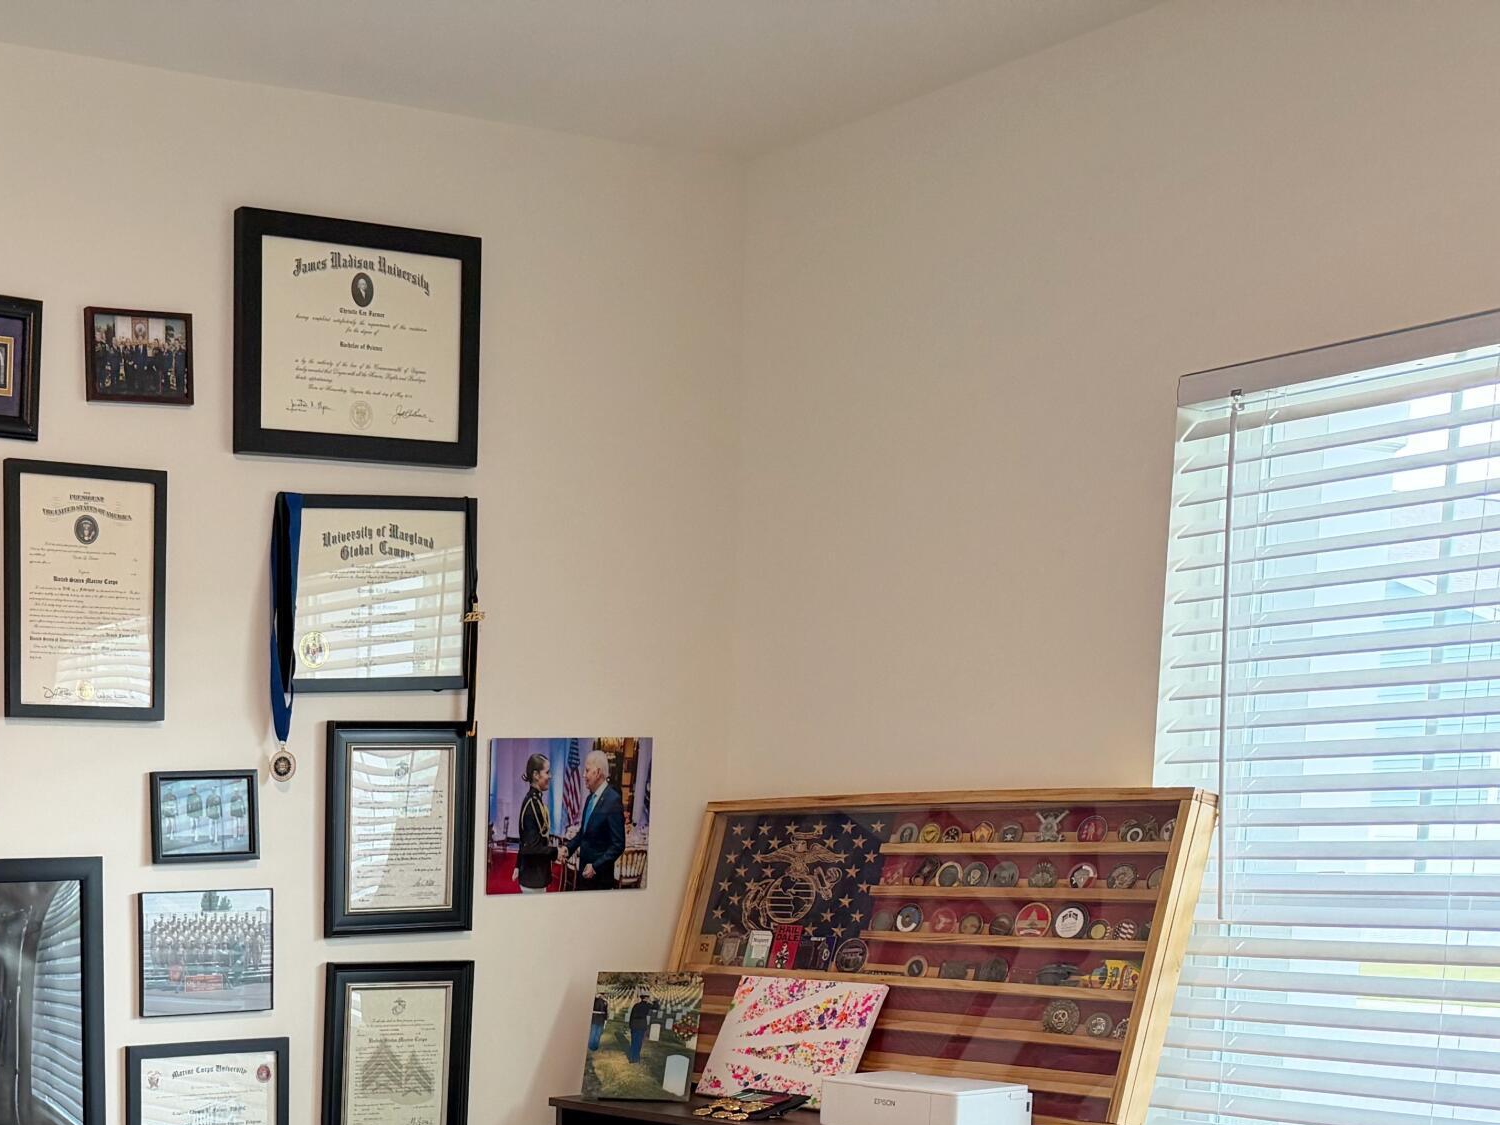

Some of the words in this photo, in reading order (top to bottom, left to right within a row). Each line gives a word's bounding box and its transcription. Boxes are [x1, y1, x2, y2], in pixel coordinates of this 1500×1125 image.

[293, 257, 328, 277] James
[330, 251, 375, 271] Madison
[378, 255, 430, 296] University
[322, 525, 373, 548] University
[376, 525, 387, 538] of
[389, 522, 434, 550] Maryland
[340, 543, 373, 561] Global
[379, 540, 416, 562] Campus
[103, 578, 118, 586] Corps
[172, 1068, 195, 1080] Marine
[195, 1065, 214, 1075] Corps
[215, 1064, 248, 1075] University
[873, 1097, 896, 1107] EPSON
